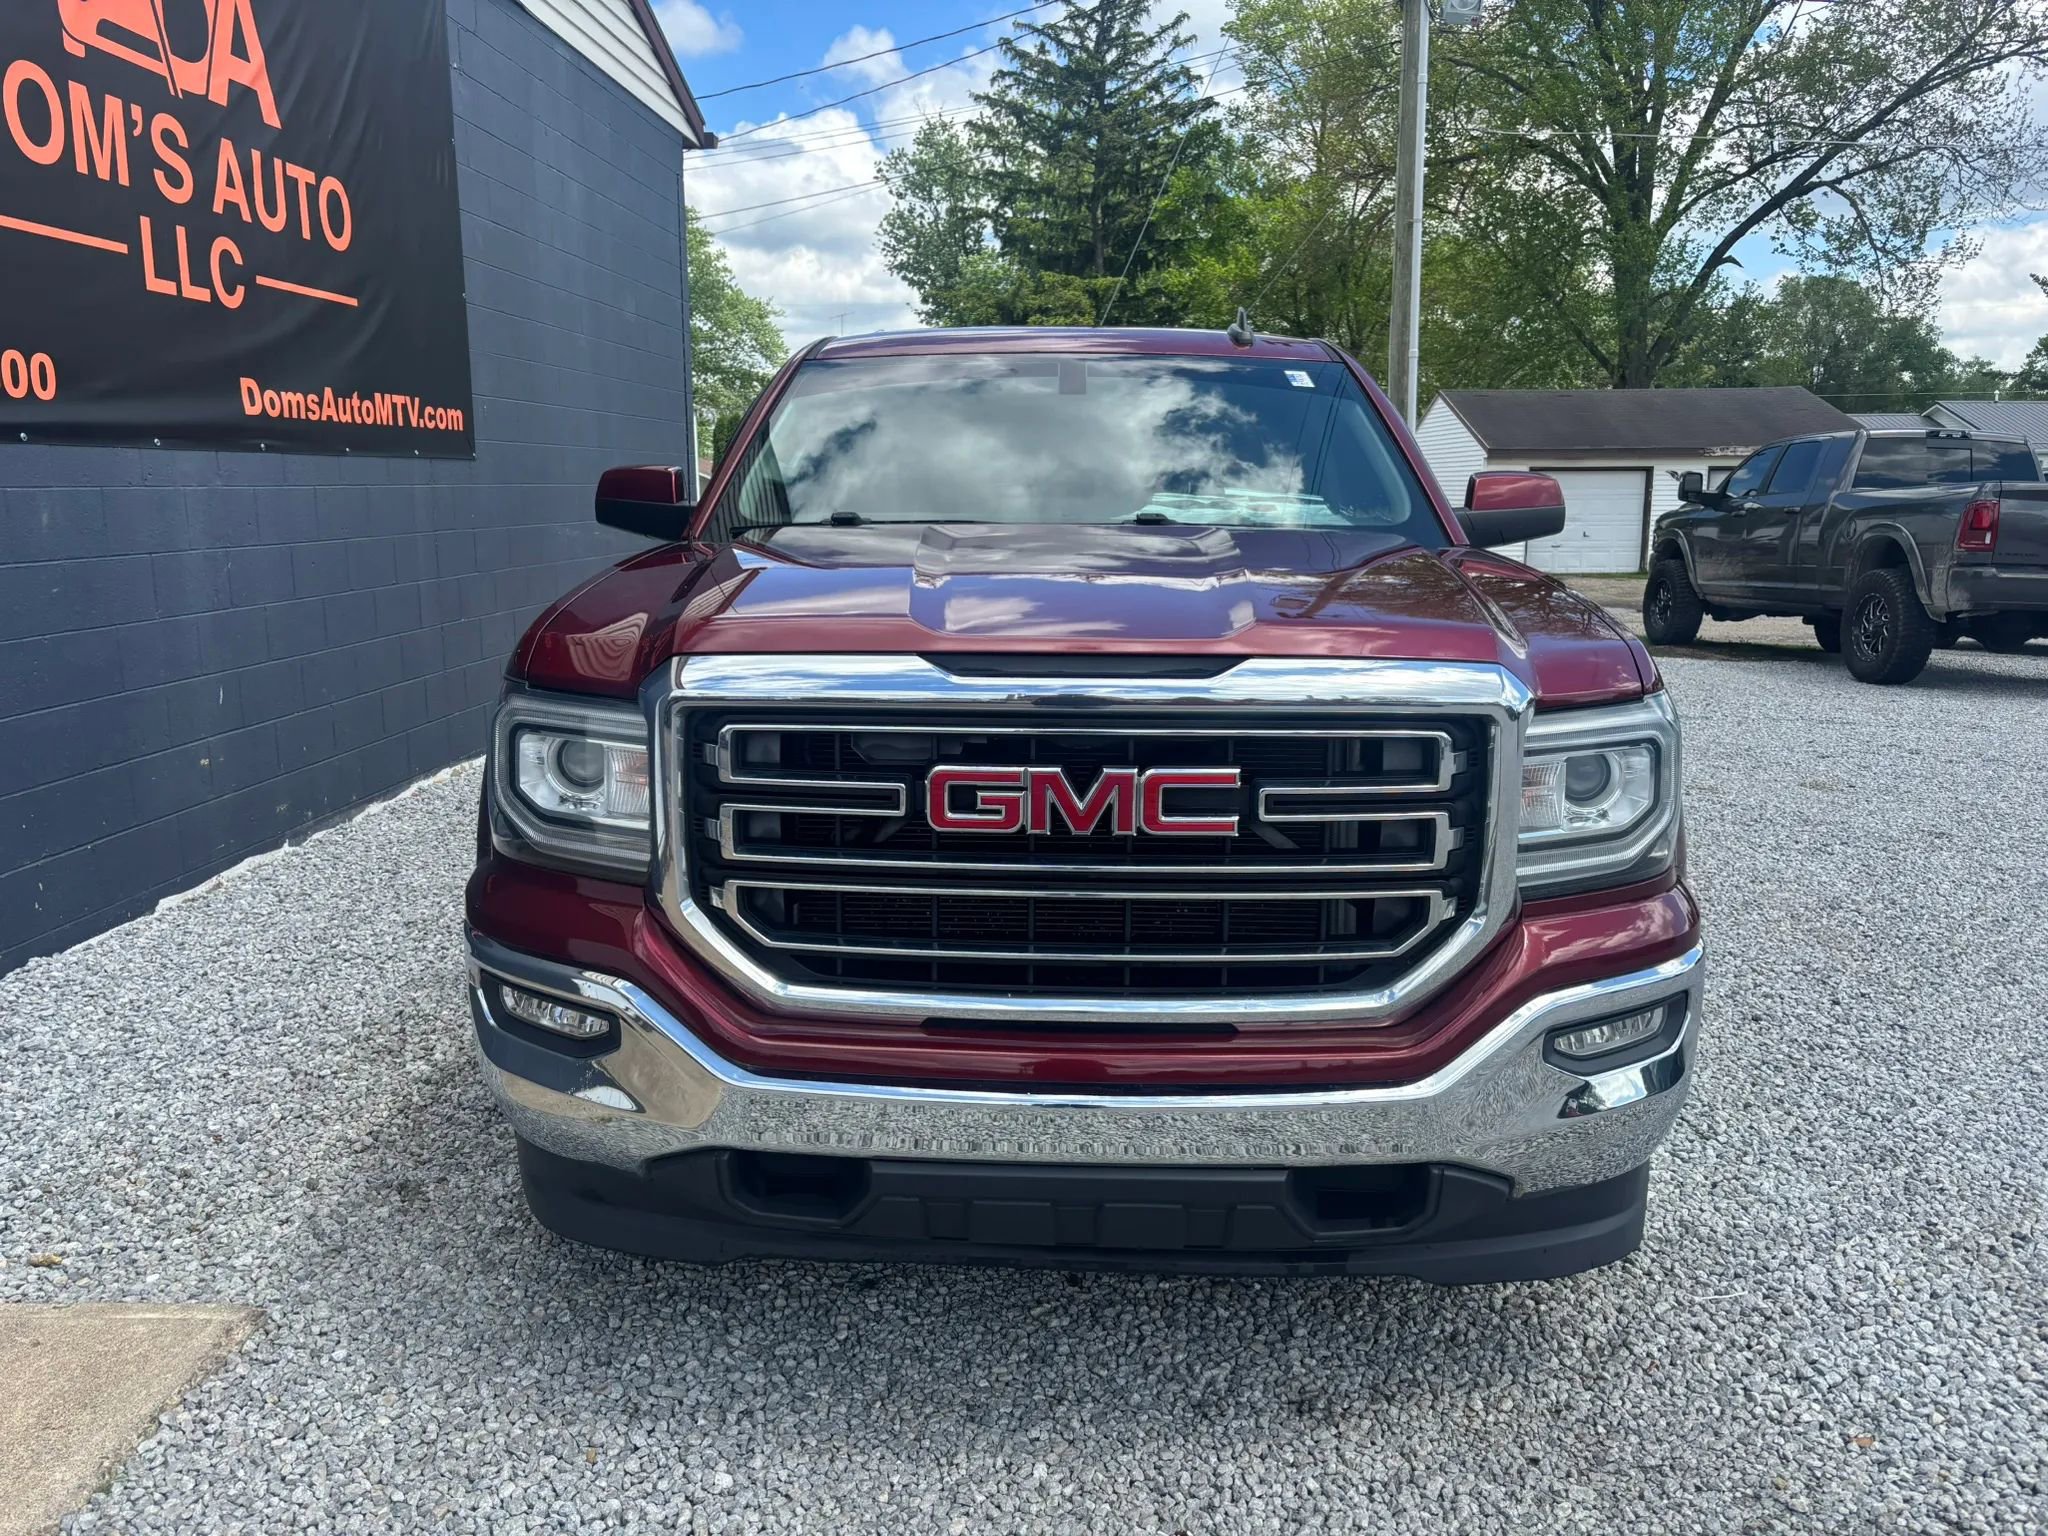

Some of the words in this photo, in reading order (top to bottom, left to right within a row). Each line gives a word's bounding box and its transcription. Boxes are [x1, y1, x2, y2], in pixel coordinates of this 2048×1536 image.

[212, 137, 353, 252] AUTO
[140, 215, 246, 310] LLC
[239, 376, 464, 431] DomsAutoMTV.com
[925, 765, 1241, 836] GMC
